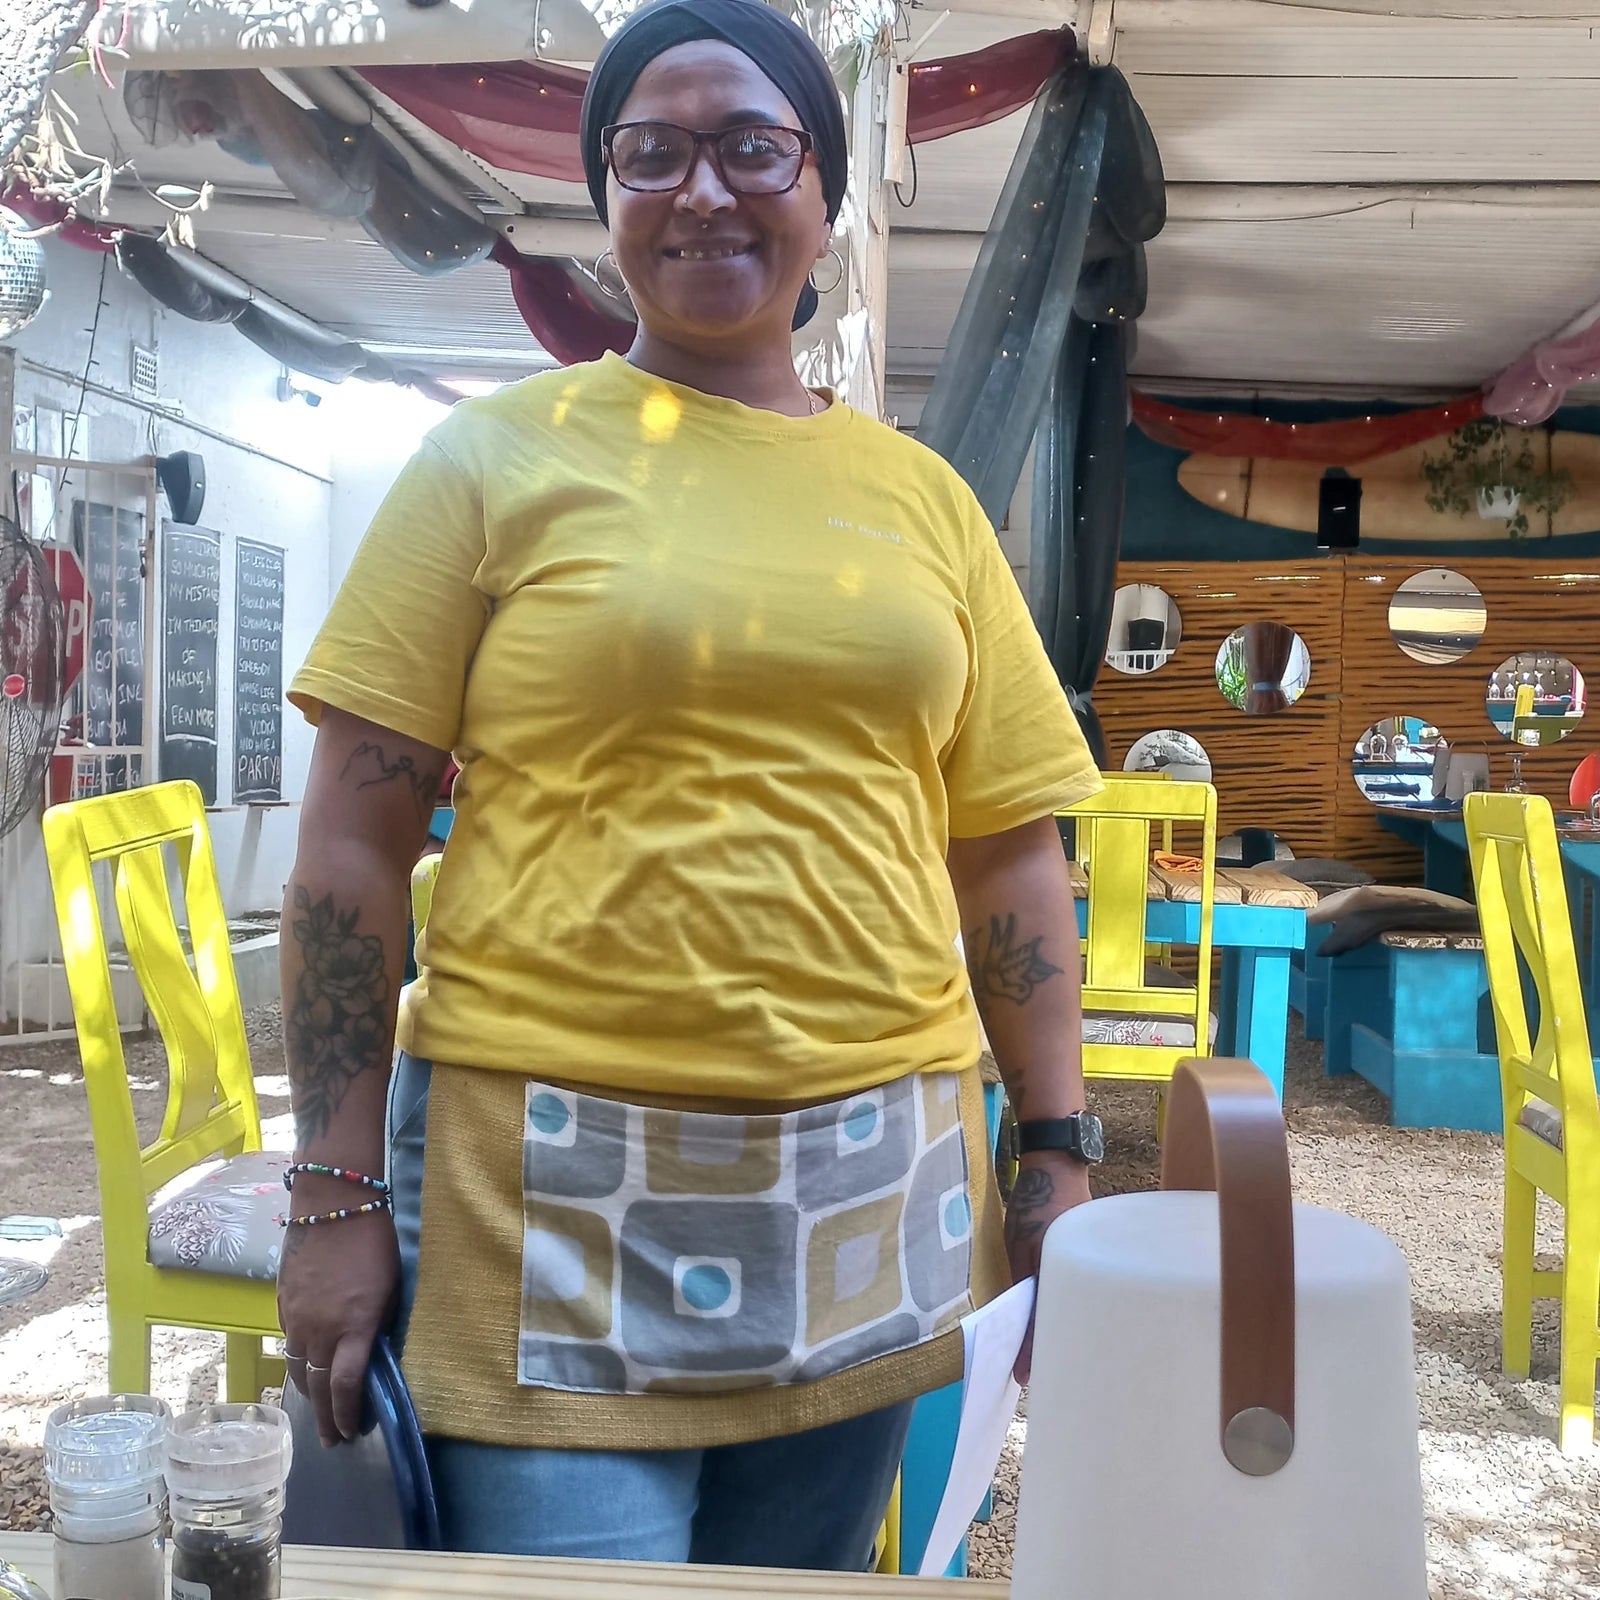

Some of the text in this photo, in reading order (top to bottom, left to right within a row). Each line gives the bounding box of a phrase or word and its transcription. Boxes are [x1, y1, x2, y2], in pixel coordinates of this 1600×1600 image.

[8, 594, 86, 658] STP
[182, 647, 196, 664] OF
[168, 667, 212, 694] MAKING A
[171, 704, 193, 726] FEW
[250, 719, 275, 736] VODKA
